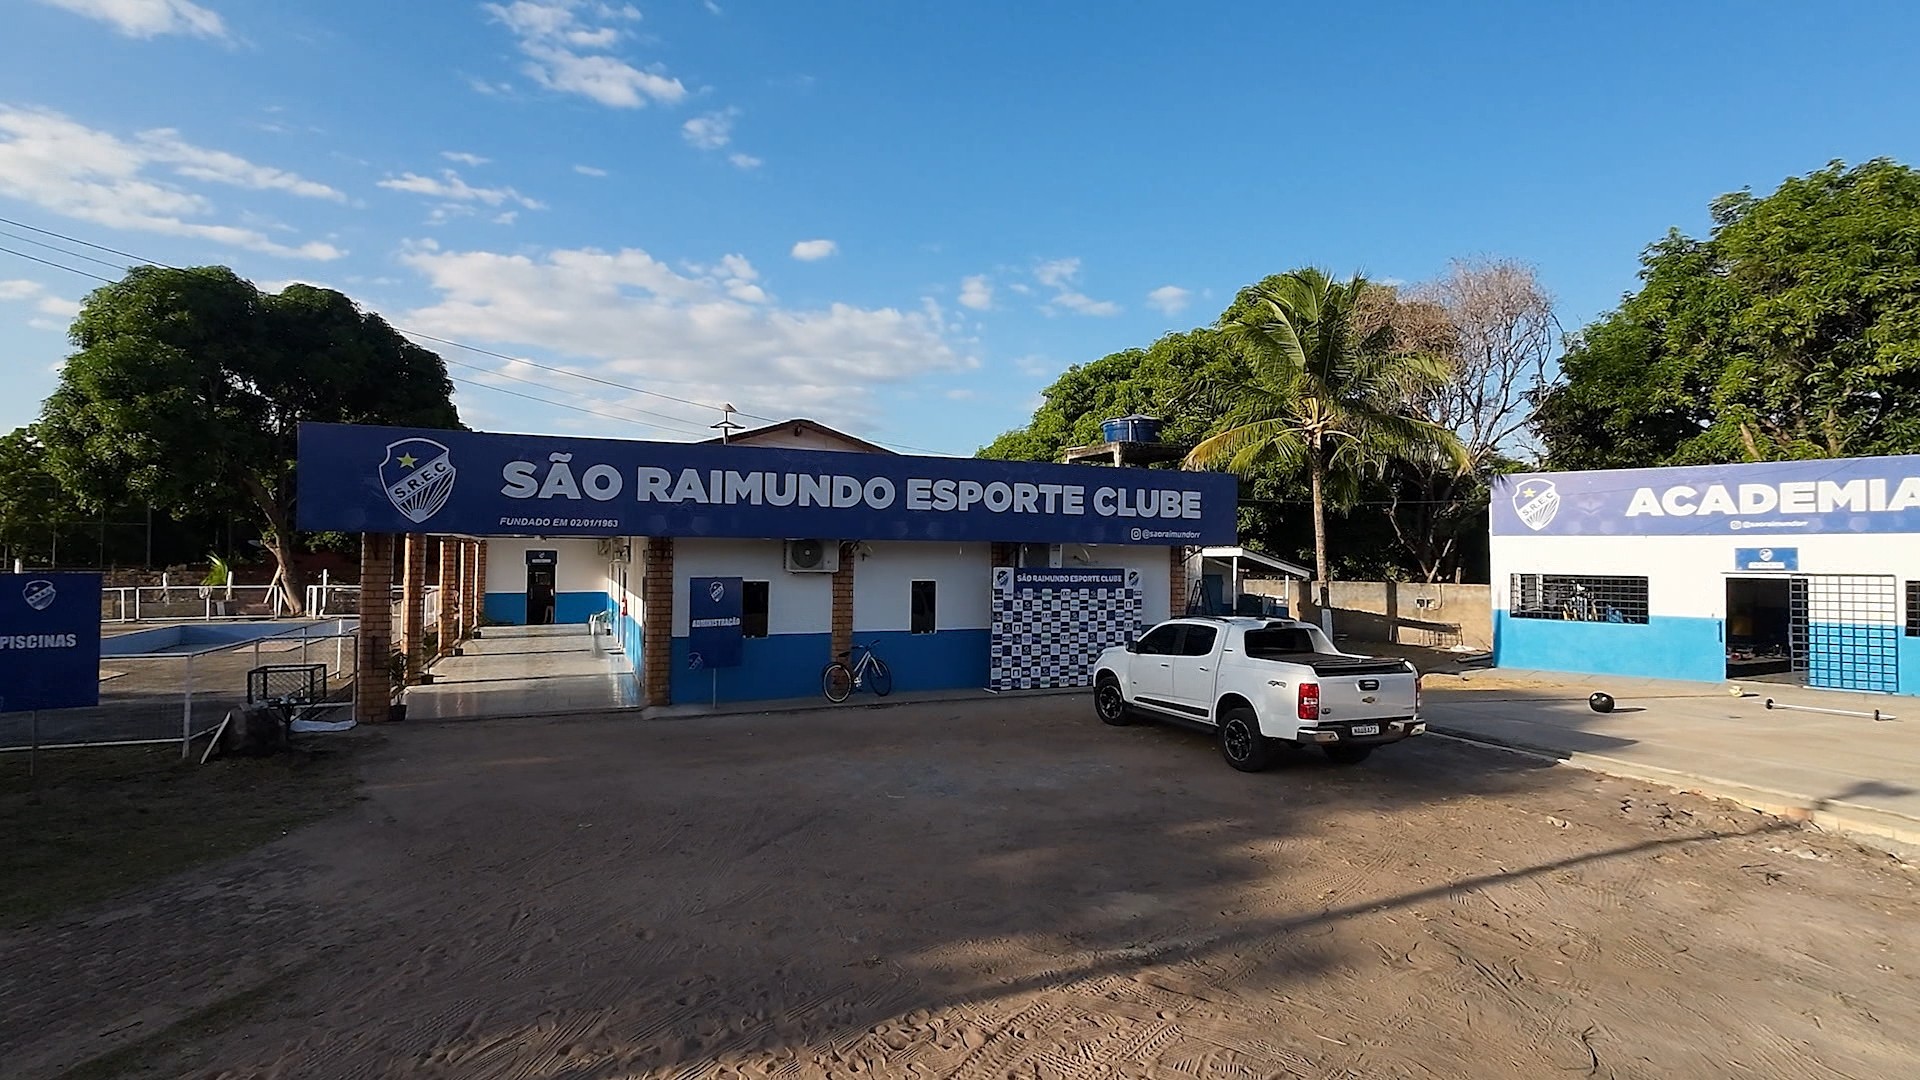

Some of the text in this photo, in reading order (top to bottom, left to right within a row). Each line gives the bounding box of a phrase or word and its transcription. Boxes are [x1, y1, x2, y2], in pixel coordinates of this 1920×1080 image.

[500, 452, 1201, 519] SÃO RAIMUNDO ESPORTE CLUBE
[1625, 476, 1920, 518] ACADEMIA
[499, 517, 619, 528] FUNDADO EM 02/01/1963
[1016, 573, 1122, 583] SÃO RAIMUNDO ESPORTE CLUBE
[0, 633, 77, 650] PISCINAS
